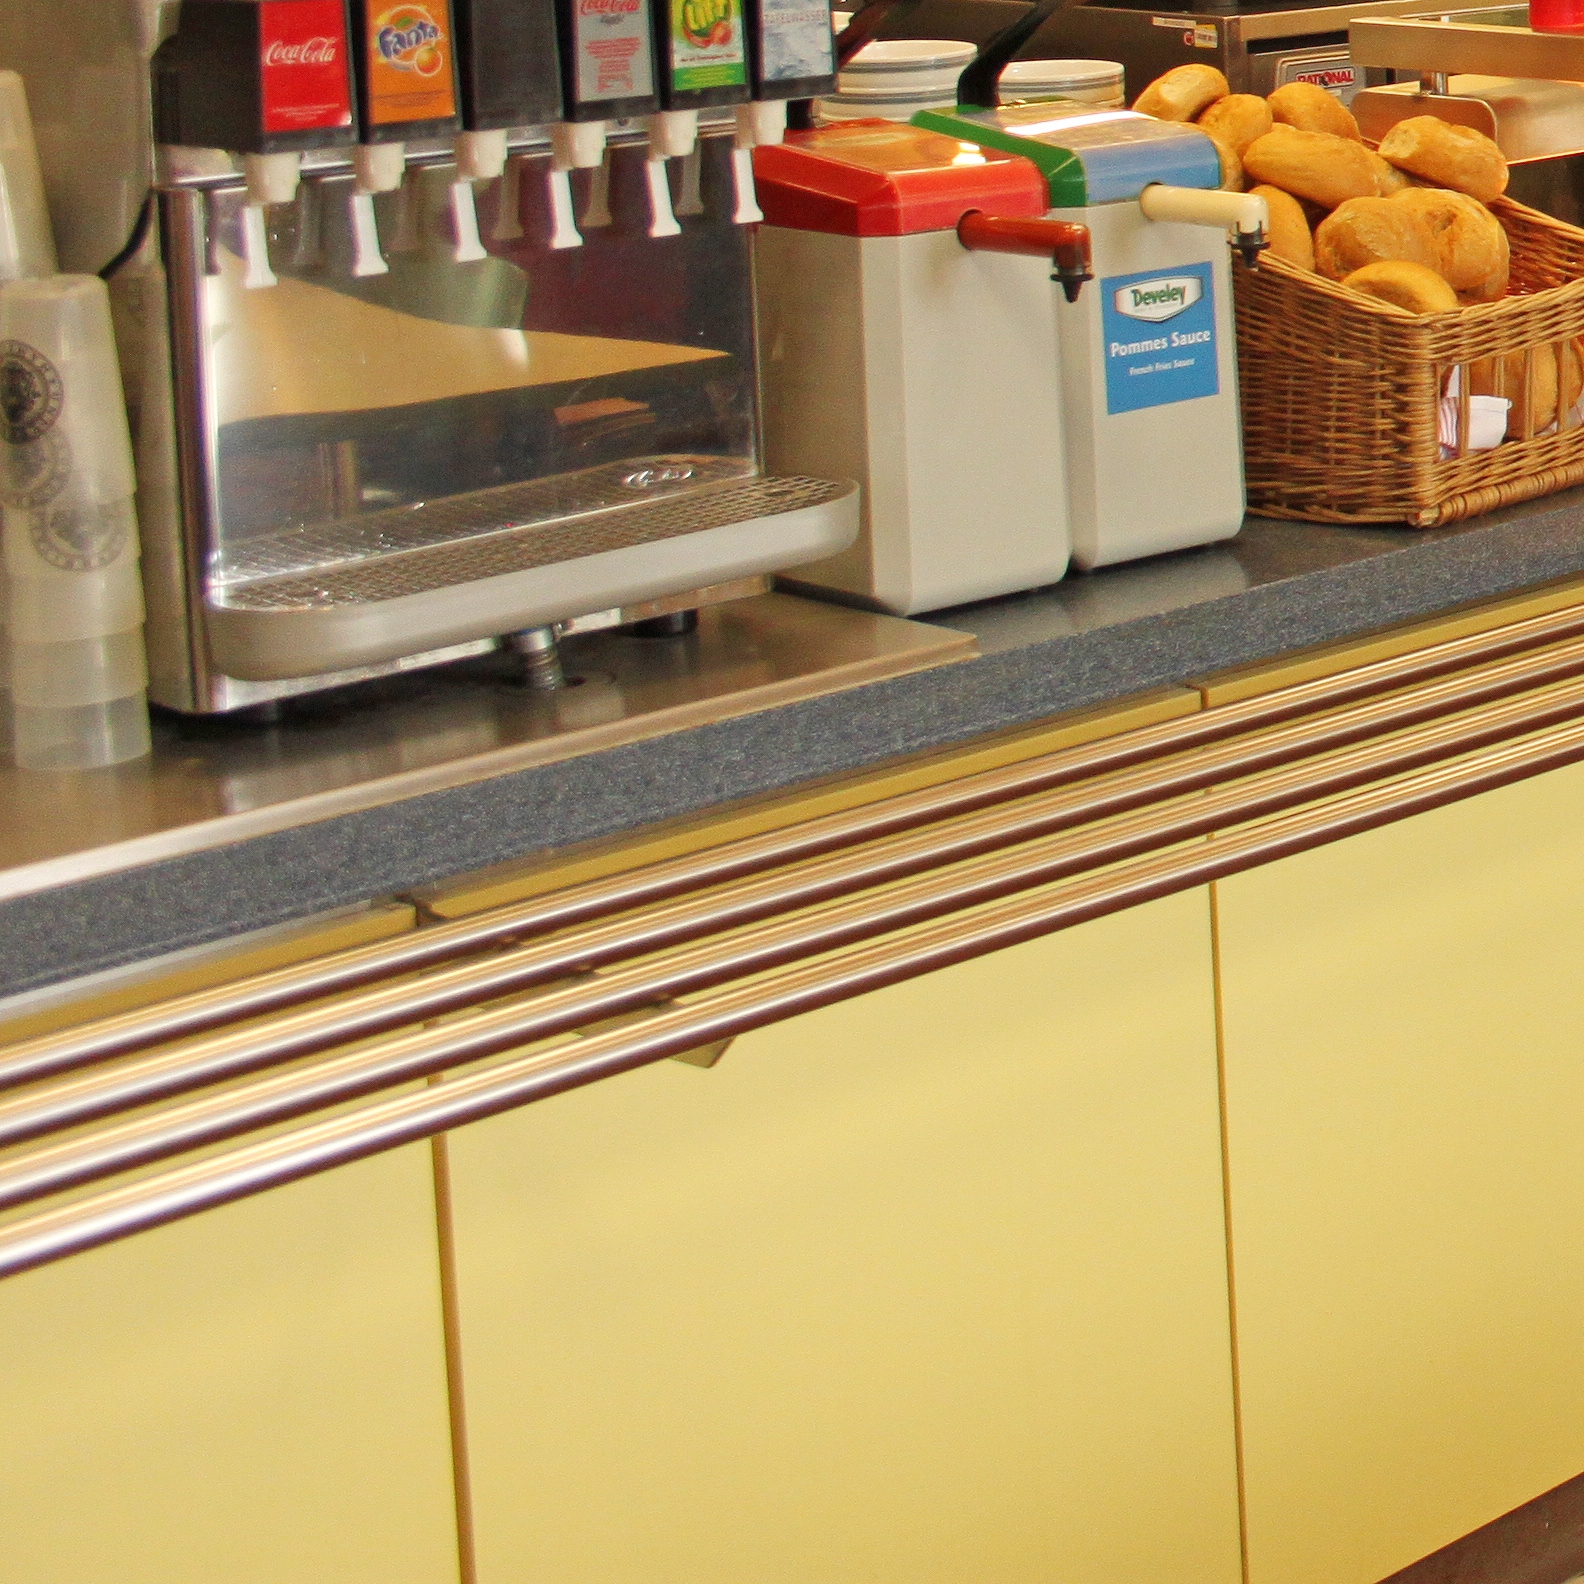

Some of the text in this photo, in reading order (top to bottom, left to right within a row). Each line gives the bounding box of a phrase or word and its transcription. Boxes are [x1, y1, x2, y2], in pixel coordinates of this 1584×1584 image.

[378, 20, 441, 61] Fanta
[1130, 284, 1187, 308] Develey
[1110, 329, 1211, 358] Pommes Sauce
